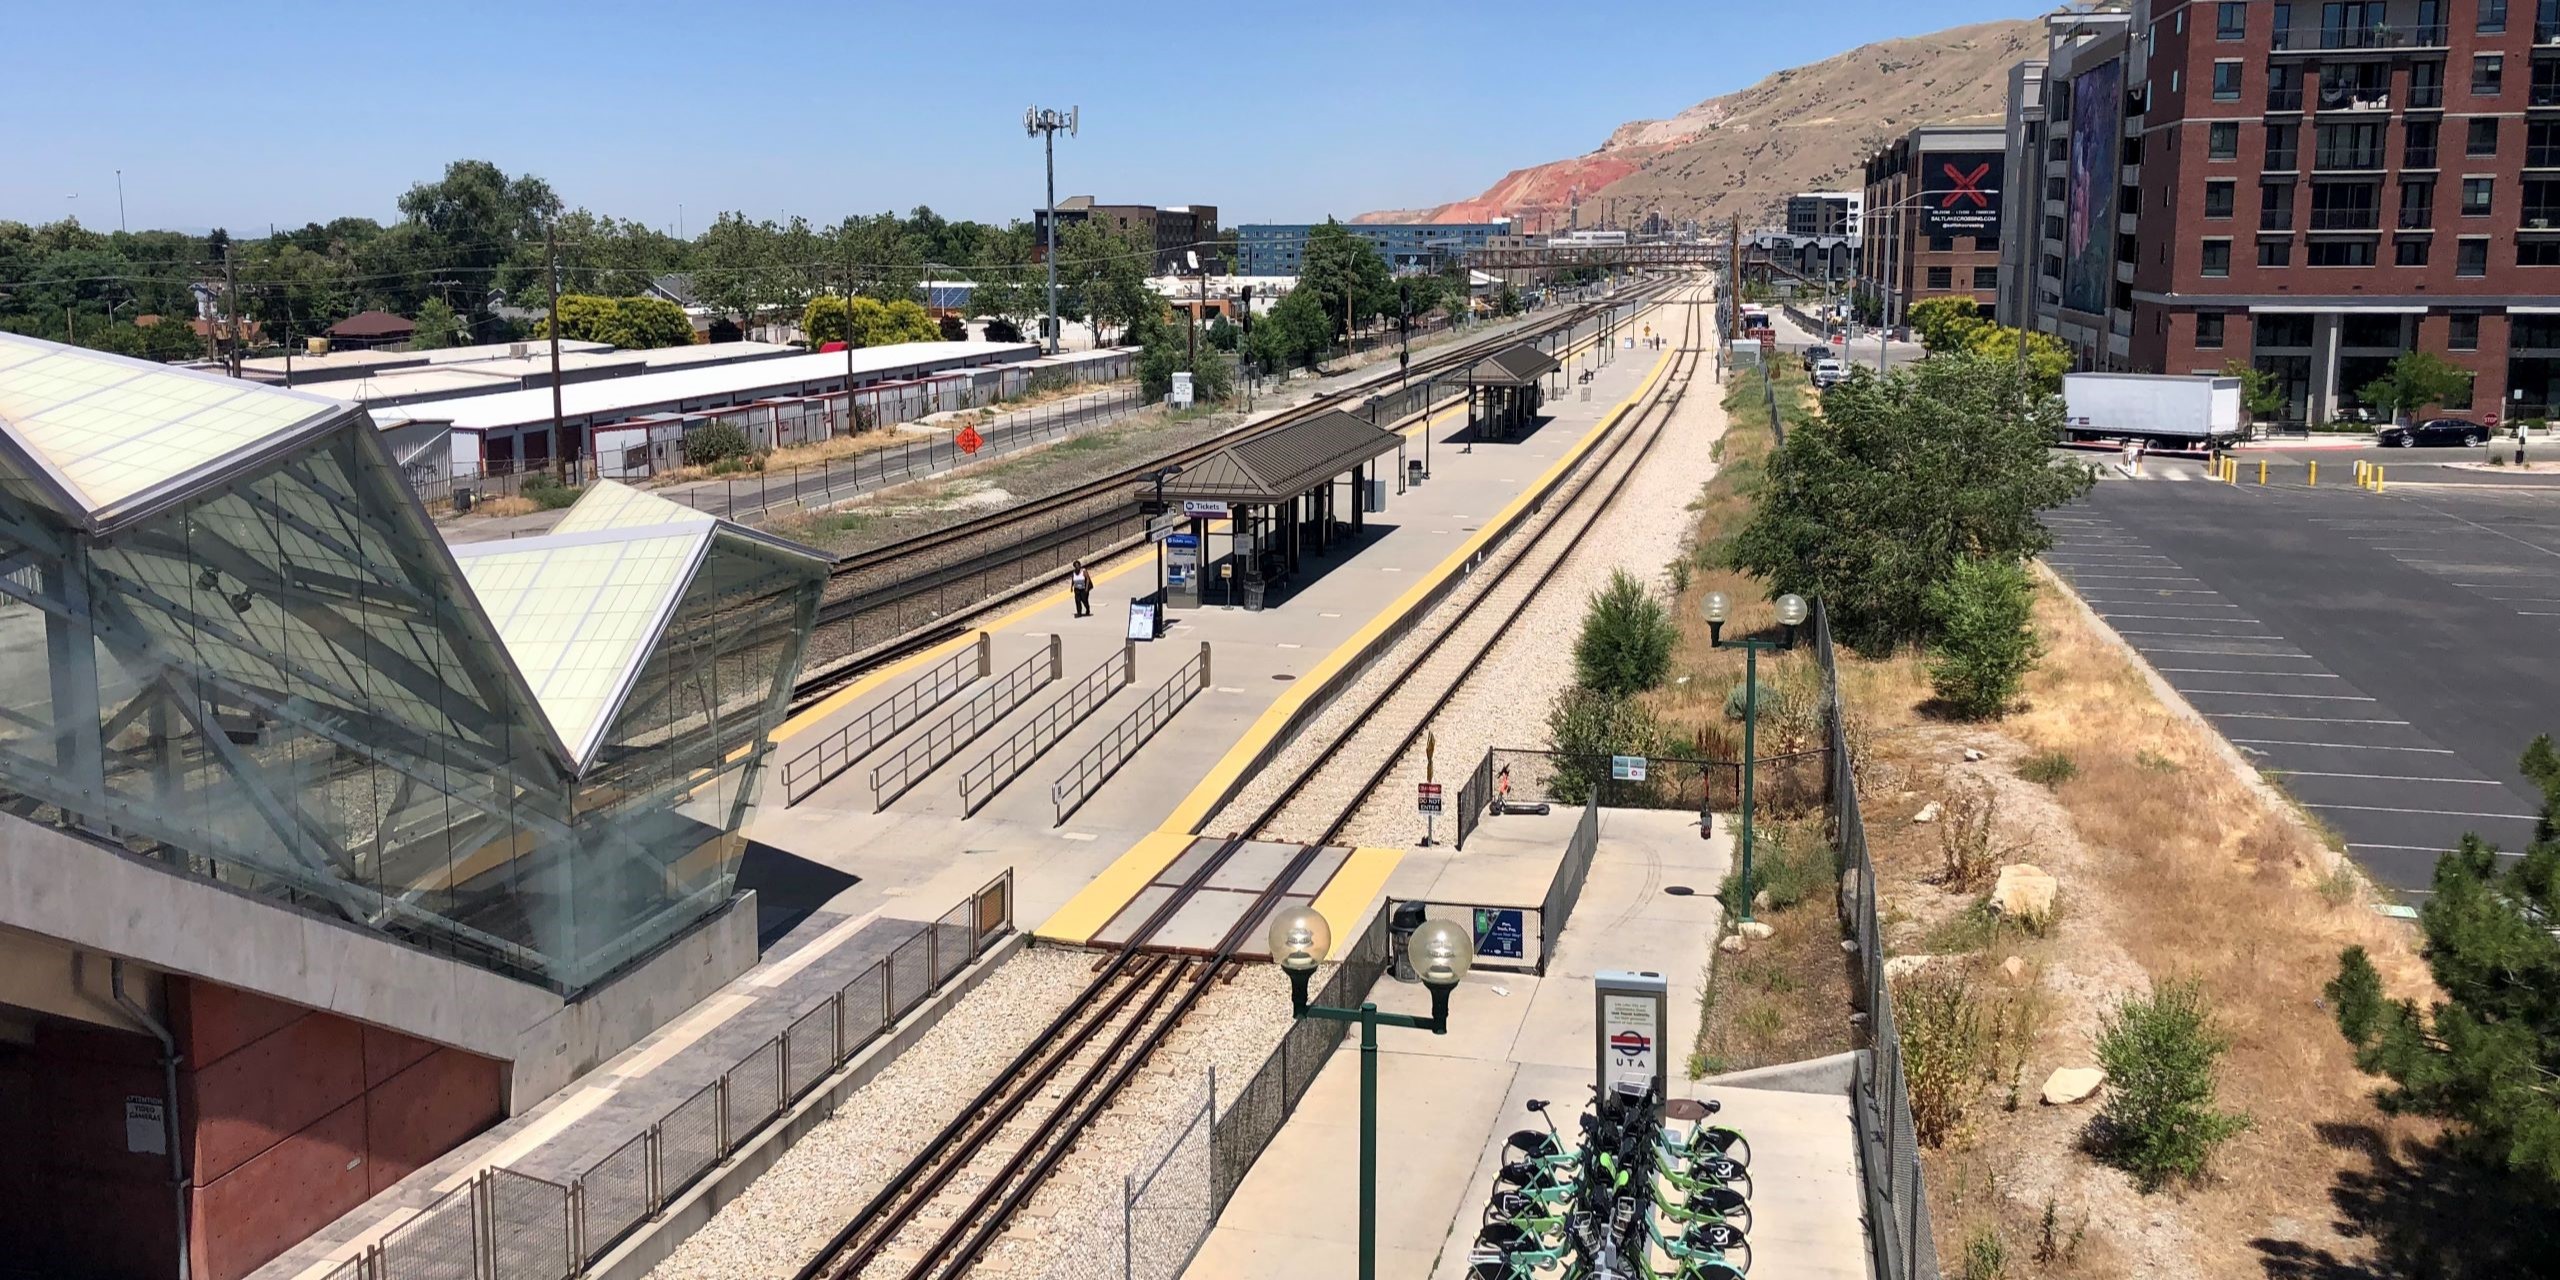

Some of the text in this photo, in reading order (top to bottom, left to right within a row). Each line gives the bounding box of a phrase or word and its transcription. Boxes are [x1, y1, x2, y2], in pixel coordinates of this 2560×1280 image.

[1616, 1058, 1645, 1068] UTA
[134, 1105, 155, 1113] VIDEO
[129, 1112, 161, 1121] CAMERAS
